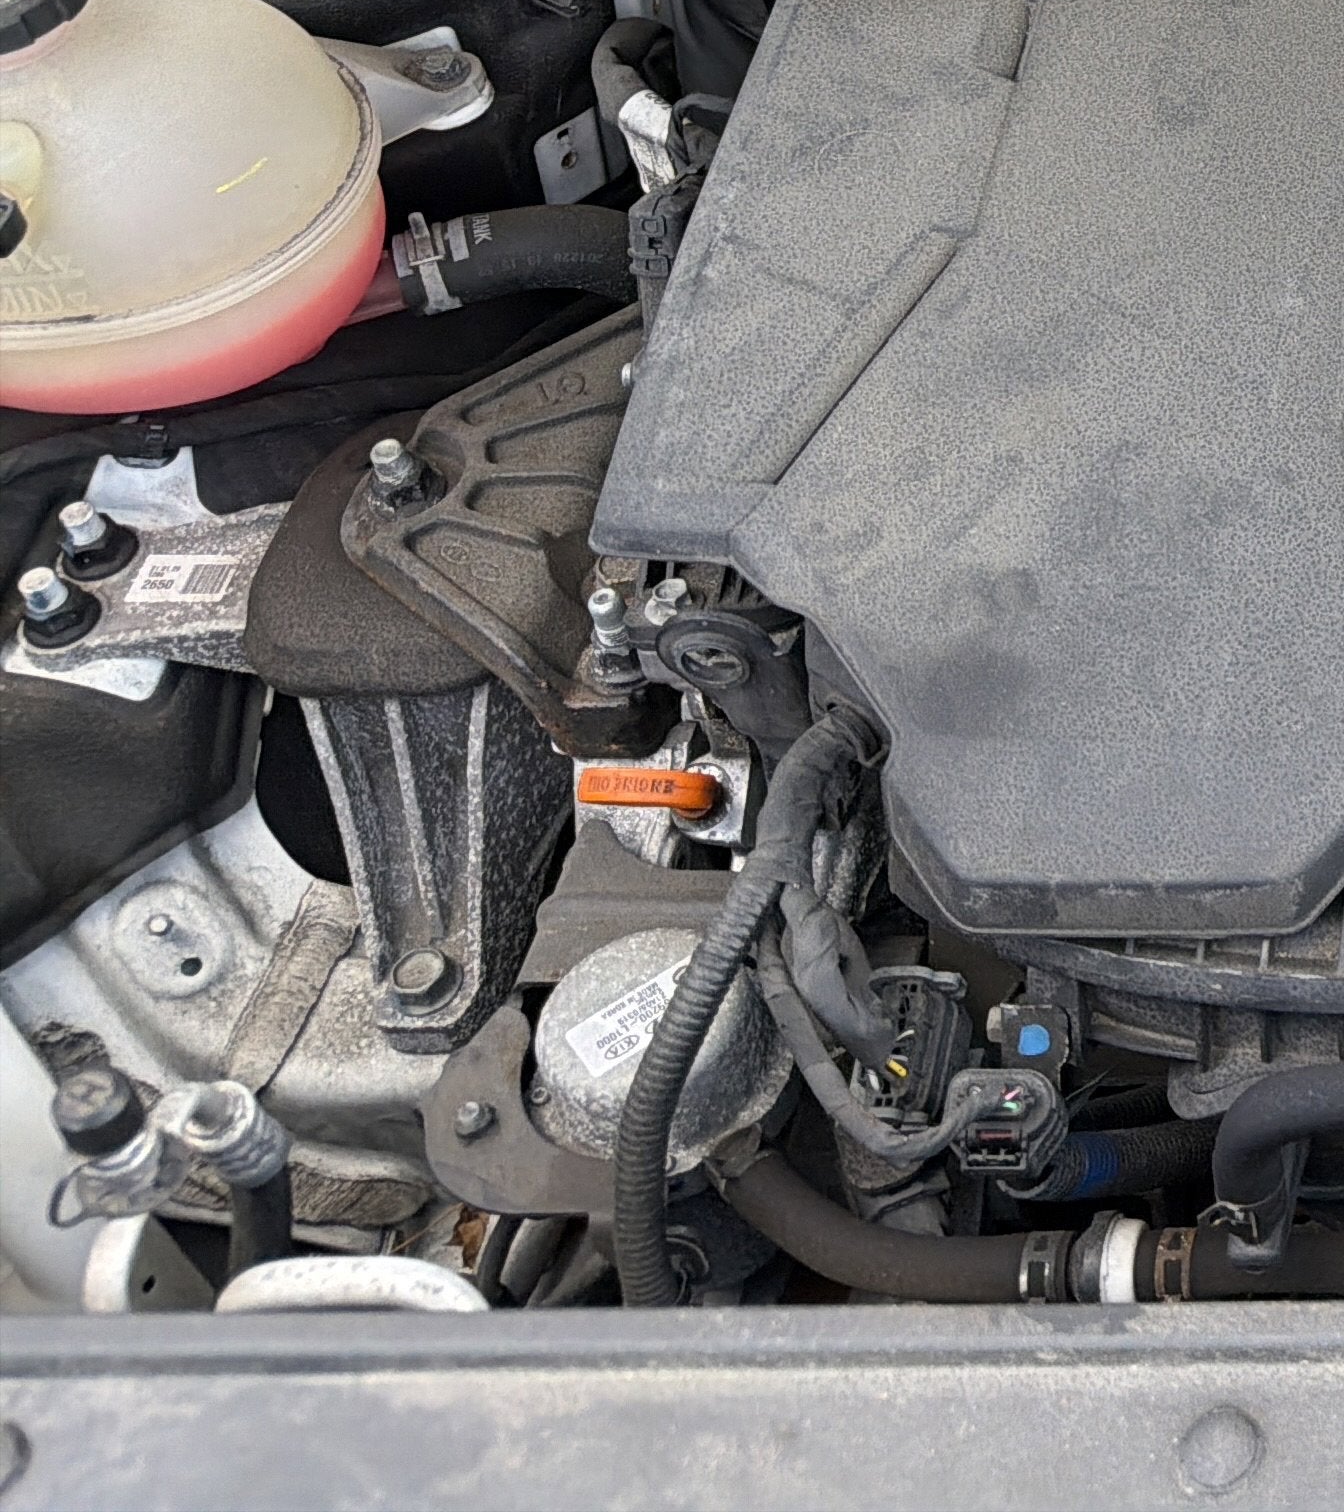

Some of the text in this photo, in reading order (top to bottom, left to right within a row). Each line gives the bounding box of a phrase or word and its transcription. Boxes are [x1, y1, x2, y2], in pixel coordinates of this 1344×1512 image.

[141, 579, 175, 590] 2650
[613, 775, 675, 796] ENGINE
[607, 1036, 636, 1058] KIA
